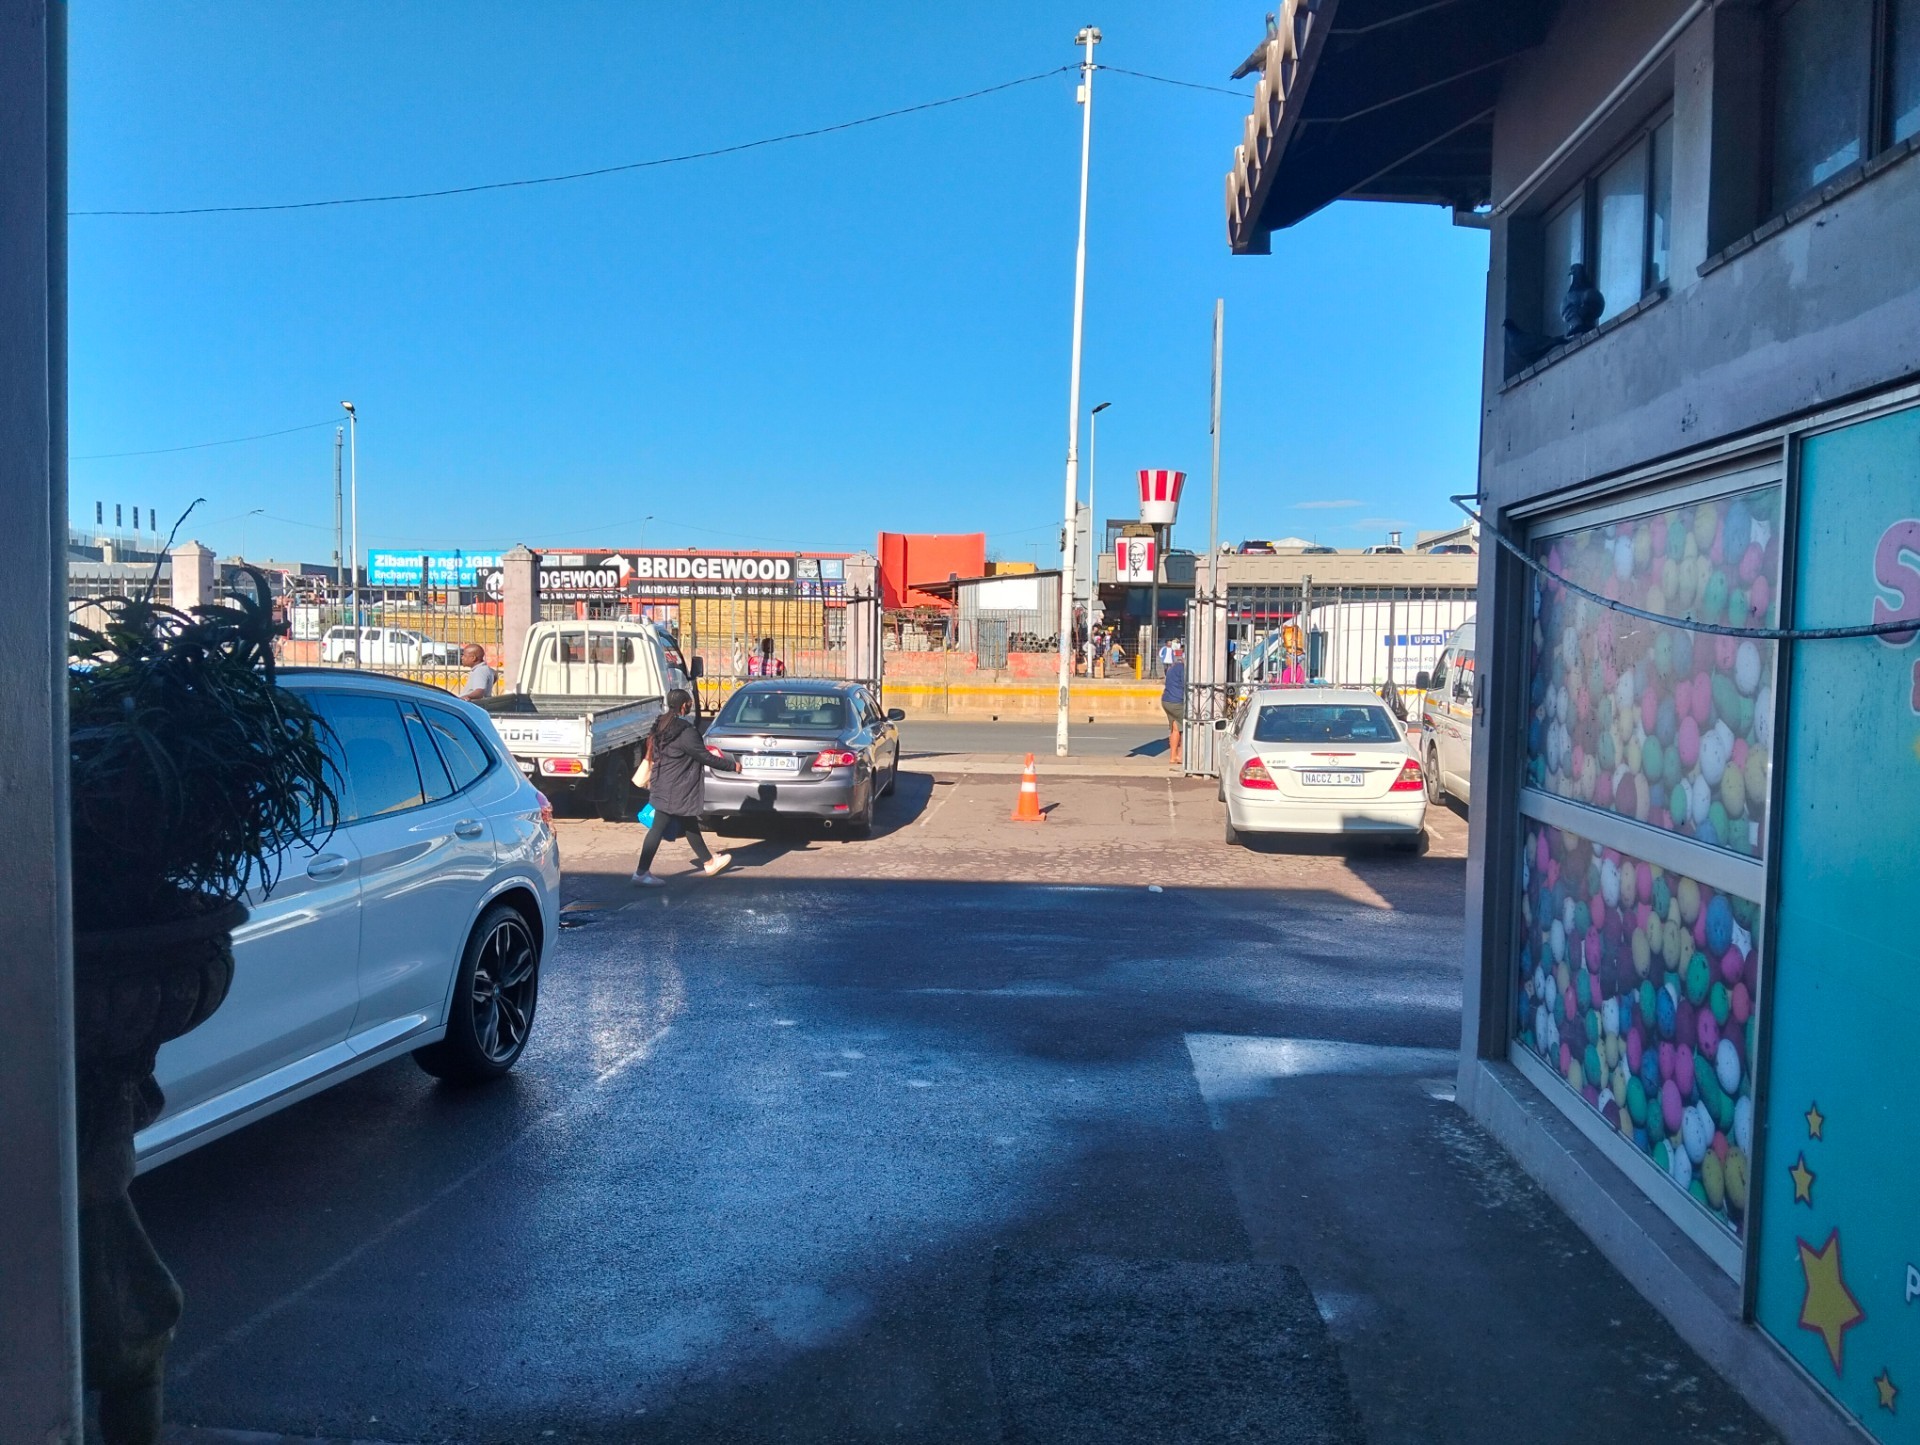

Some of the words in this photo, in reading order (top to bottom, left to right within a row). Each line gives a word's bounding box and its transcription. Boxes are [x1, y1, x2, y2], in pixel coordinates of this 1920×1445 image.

[637, 557, 790, 580] BRIDGEWOOD
[540, 570, 618, 588] DGEWOOD
[1414, 636, 1441, 644] UPPER
[785, 758, 796, 767] ZN
[1305, 774, 1332, 783] NACCZ
[1336, 774, 1342, 783] 1
[1350, 774, 1361, 783] ZN
